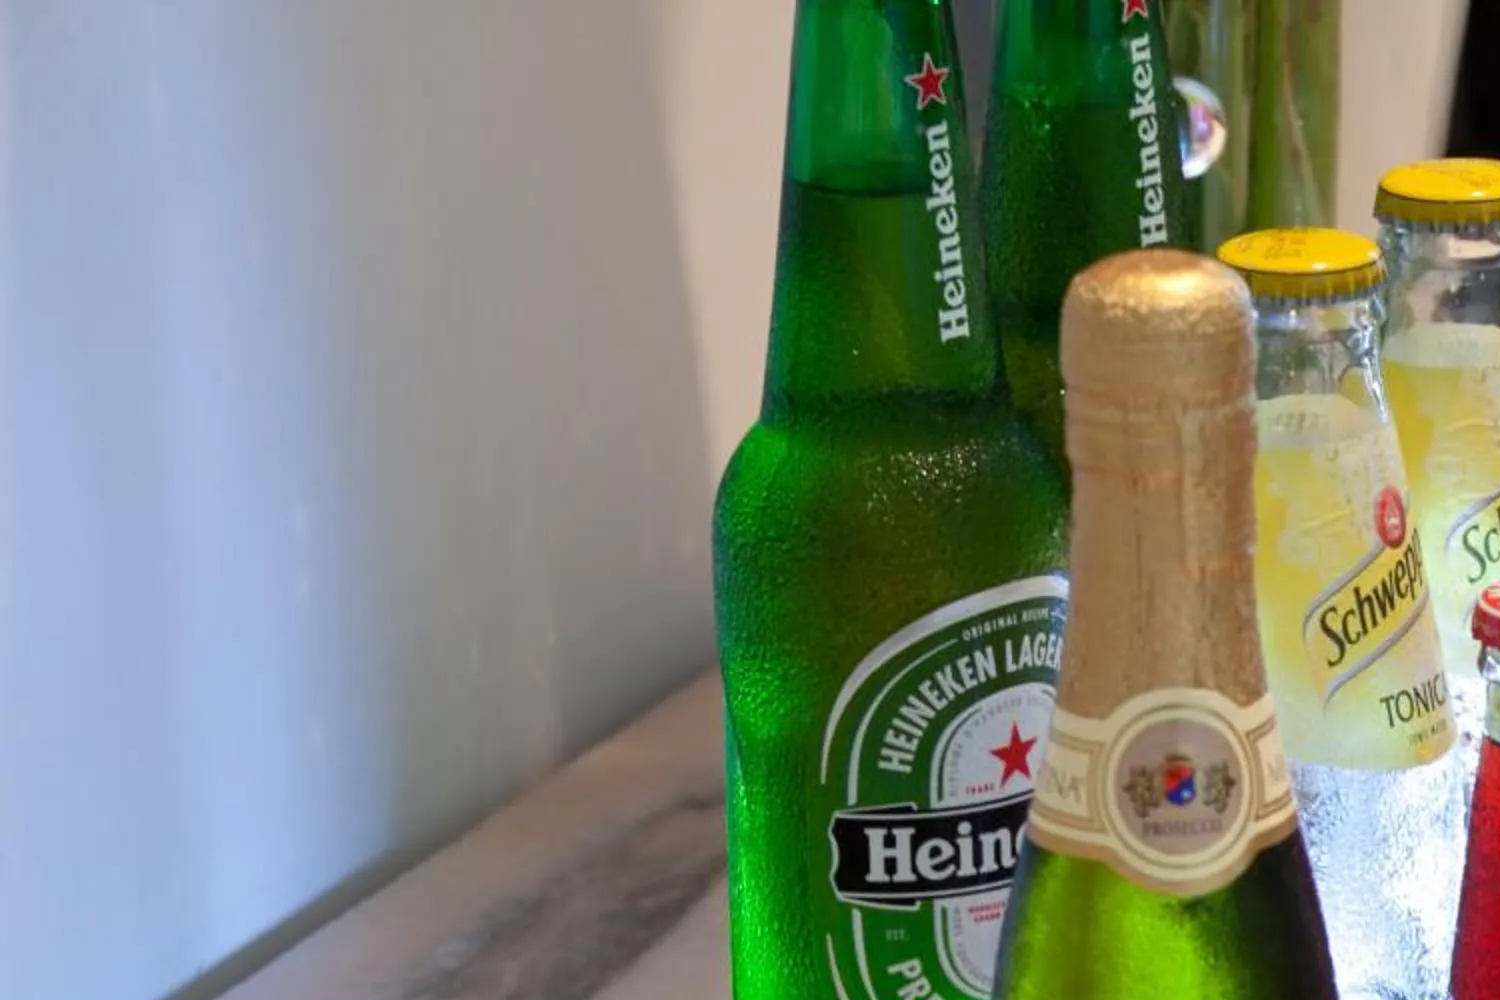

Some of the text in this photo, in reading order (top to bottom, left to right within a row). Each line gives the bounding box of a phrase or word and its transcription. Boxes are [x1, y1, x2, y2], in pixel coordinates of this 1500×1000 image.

[1130, 32, 1169, 249] Heineken
[925, 120, 970, 344] Heineken
[877, 644, 998, 775] HEINEKEN
[863, 820, 1027, 885] Hein
